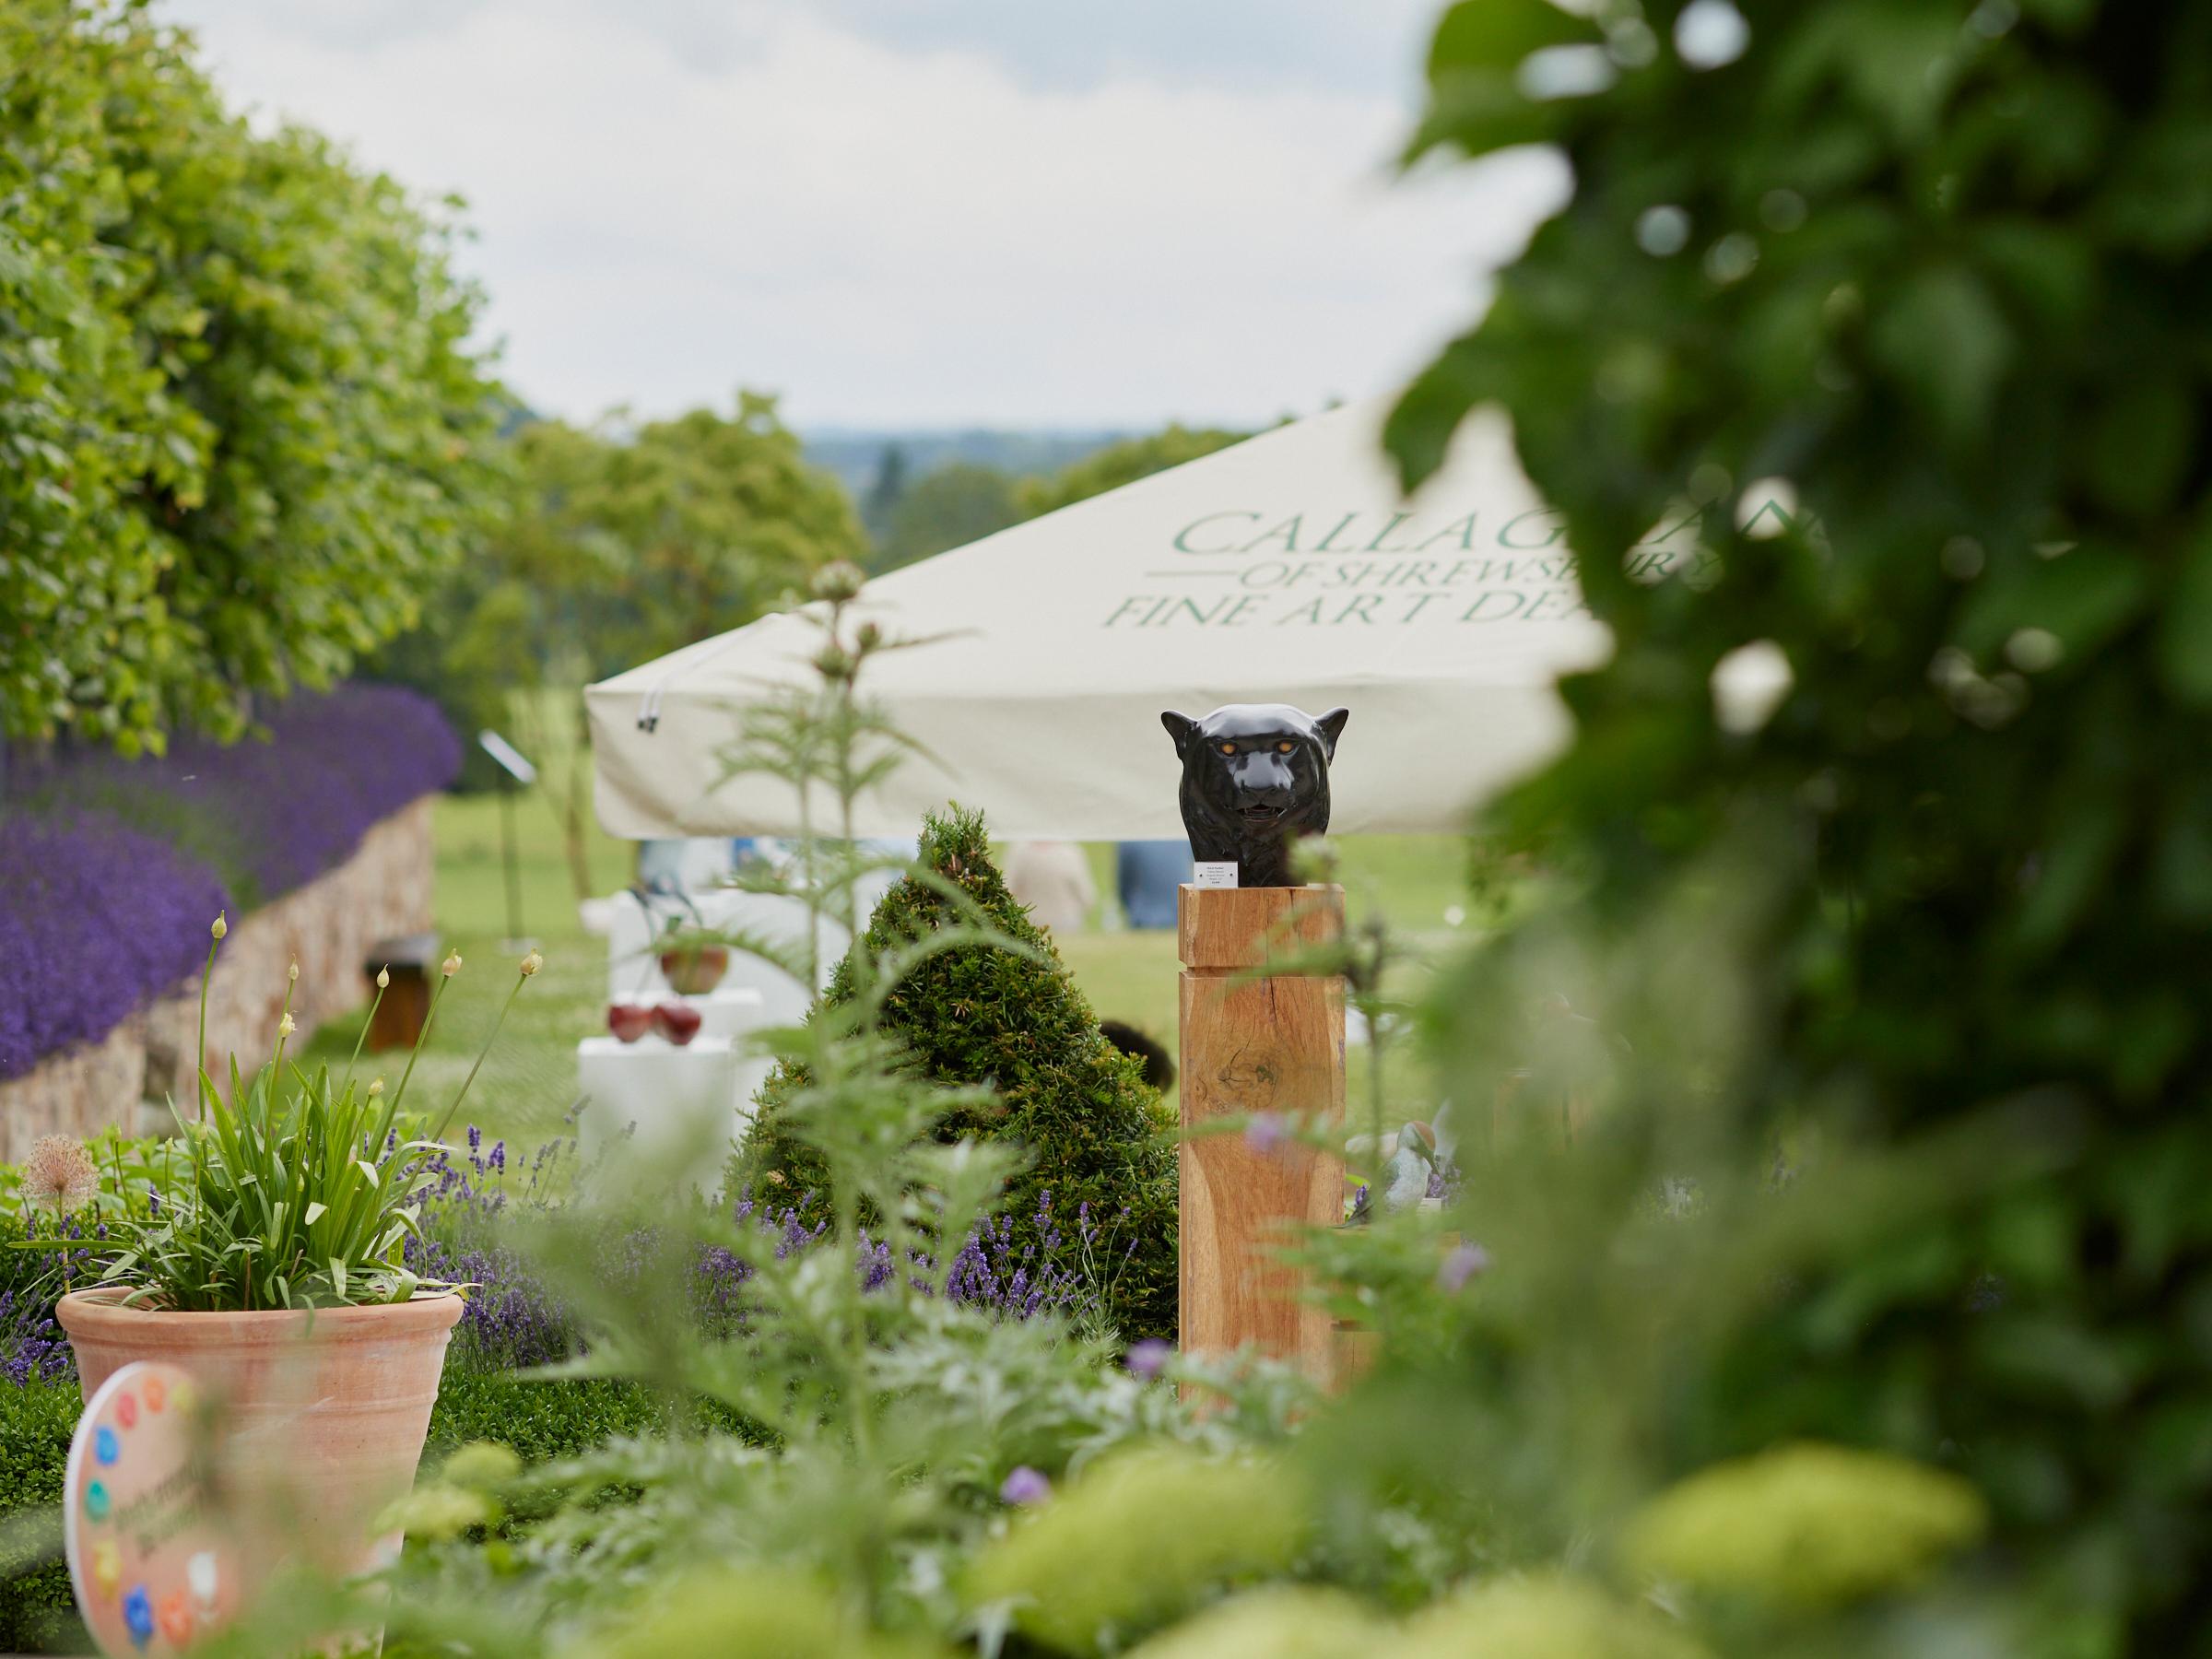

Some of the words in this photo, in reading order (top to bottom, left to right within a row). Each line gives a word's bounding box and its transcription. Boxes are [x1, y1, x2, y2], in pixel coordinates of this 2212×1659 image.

[1241, 560, 1325, 589] OF
[1102, 594, 1271, 627] FINE
[1274, 593, 1453, 626] ART
